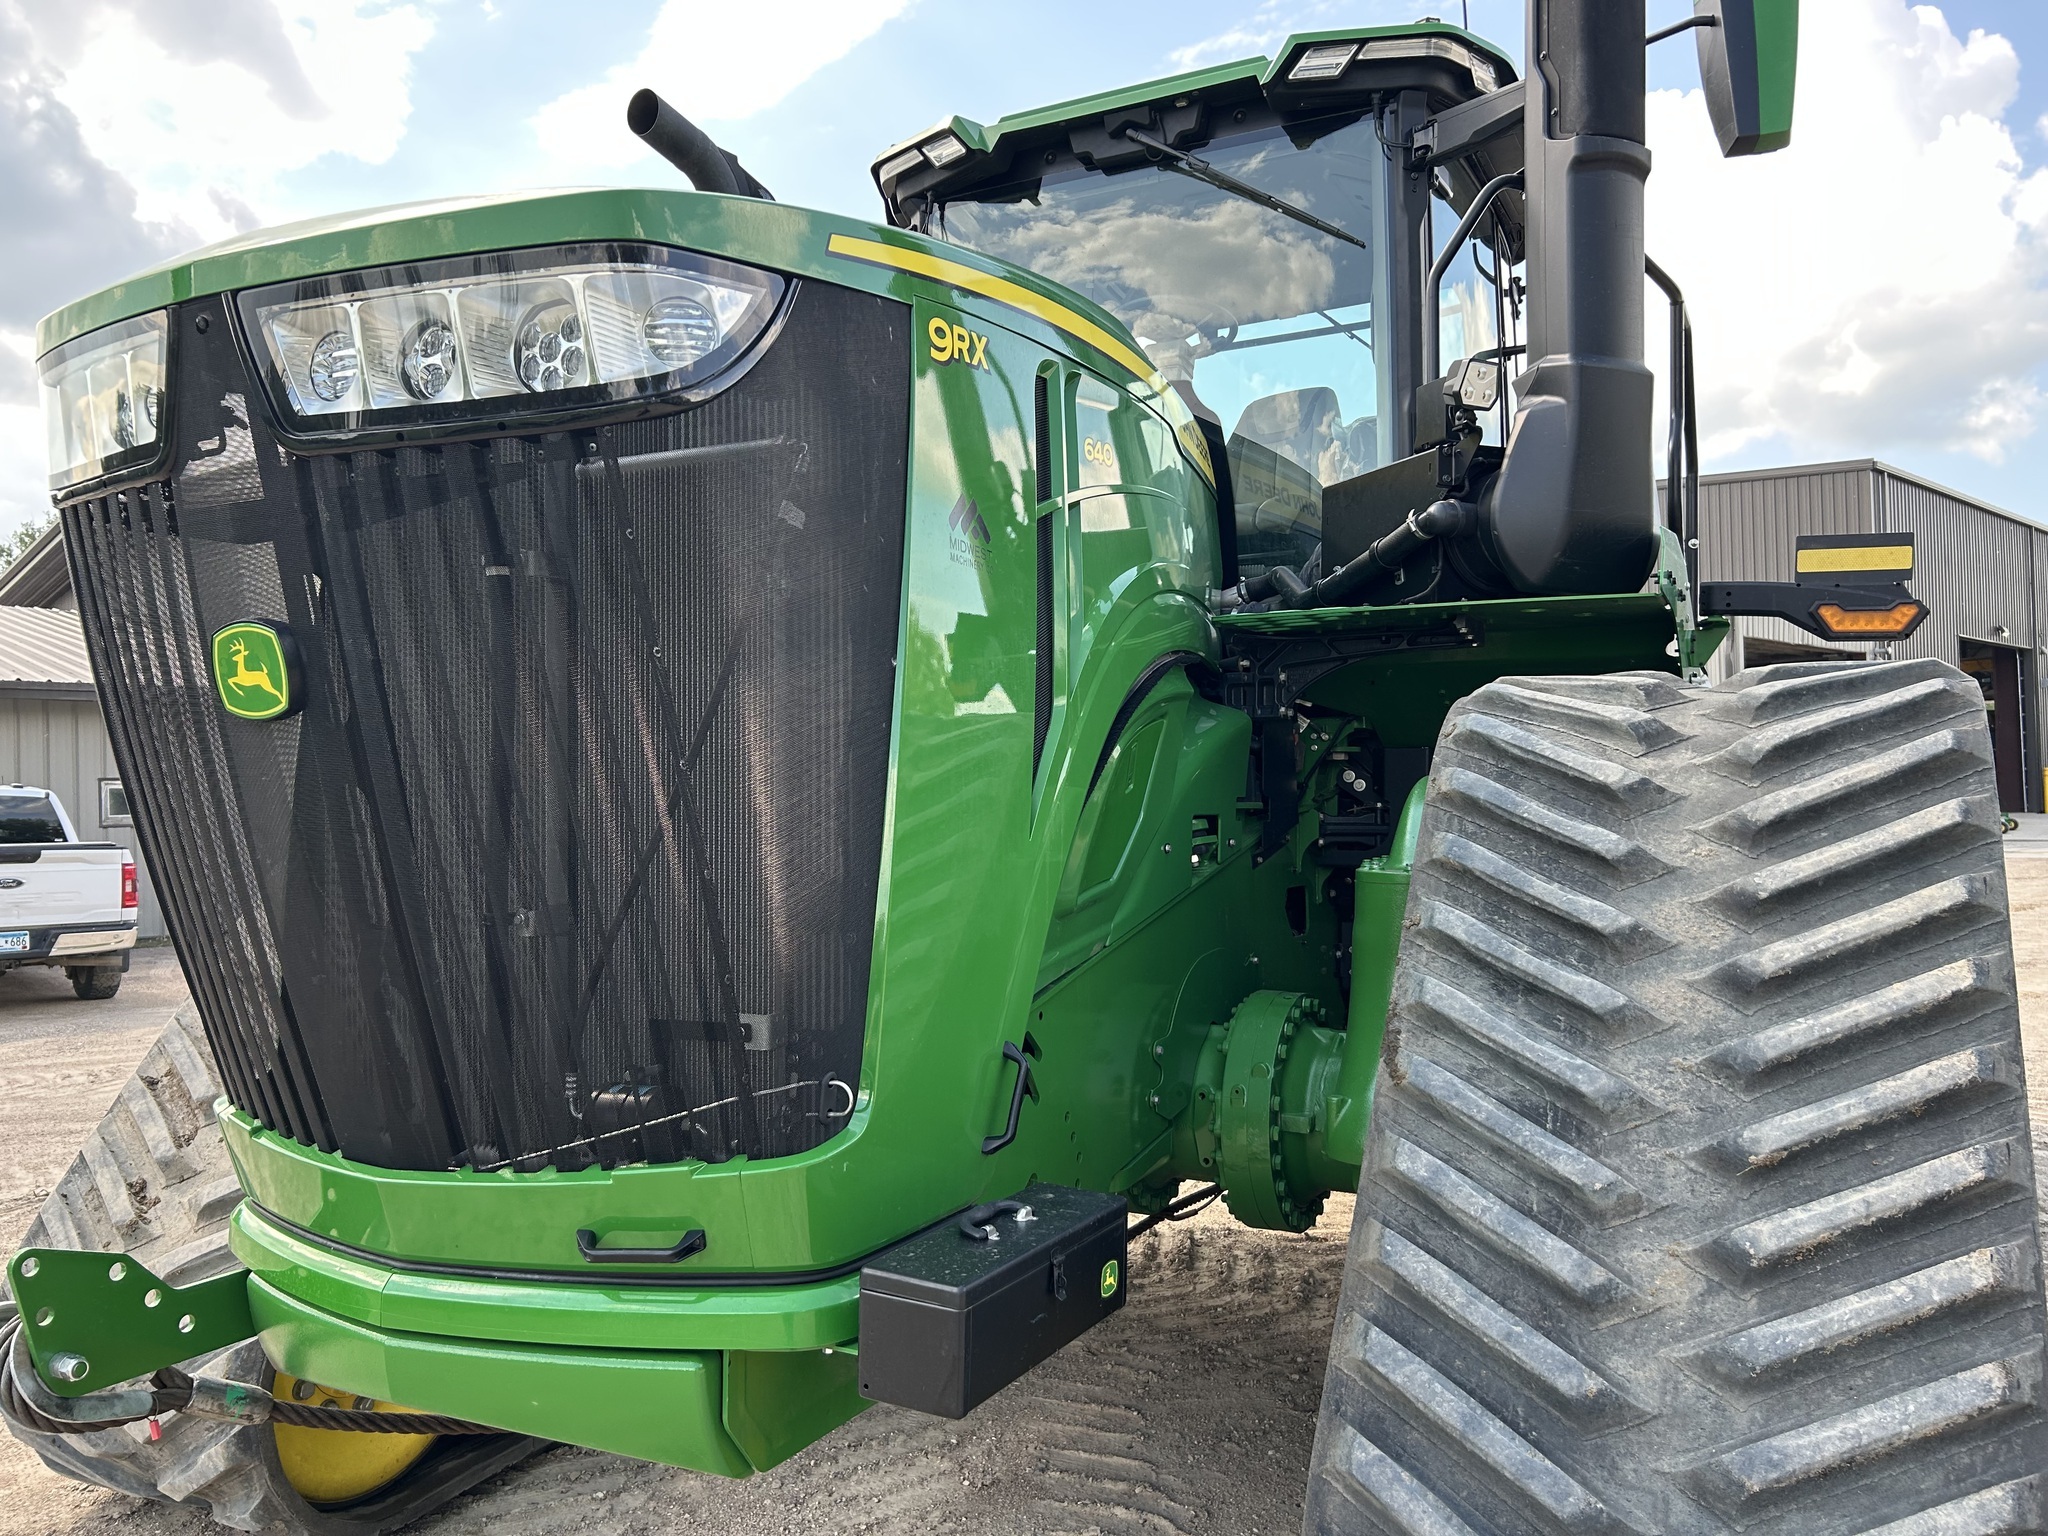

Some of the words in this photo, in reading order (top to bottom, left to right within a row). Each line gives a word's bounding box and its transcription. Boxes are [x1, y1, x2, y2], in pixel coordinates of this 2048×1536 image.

[928, 317, 991, 373] 9RX
[1084, 437, 1114, 467] 640
[950, 536, 992, 561] MIDWEST
[950, 551, 985, 571] MACHINERY
[10, 936, 27, 947] 686
